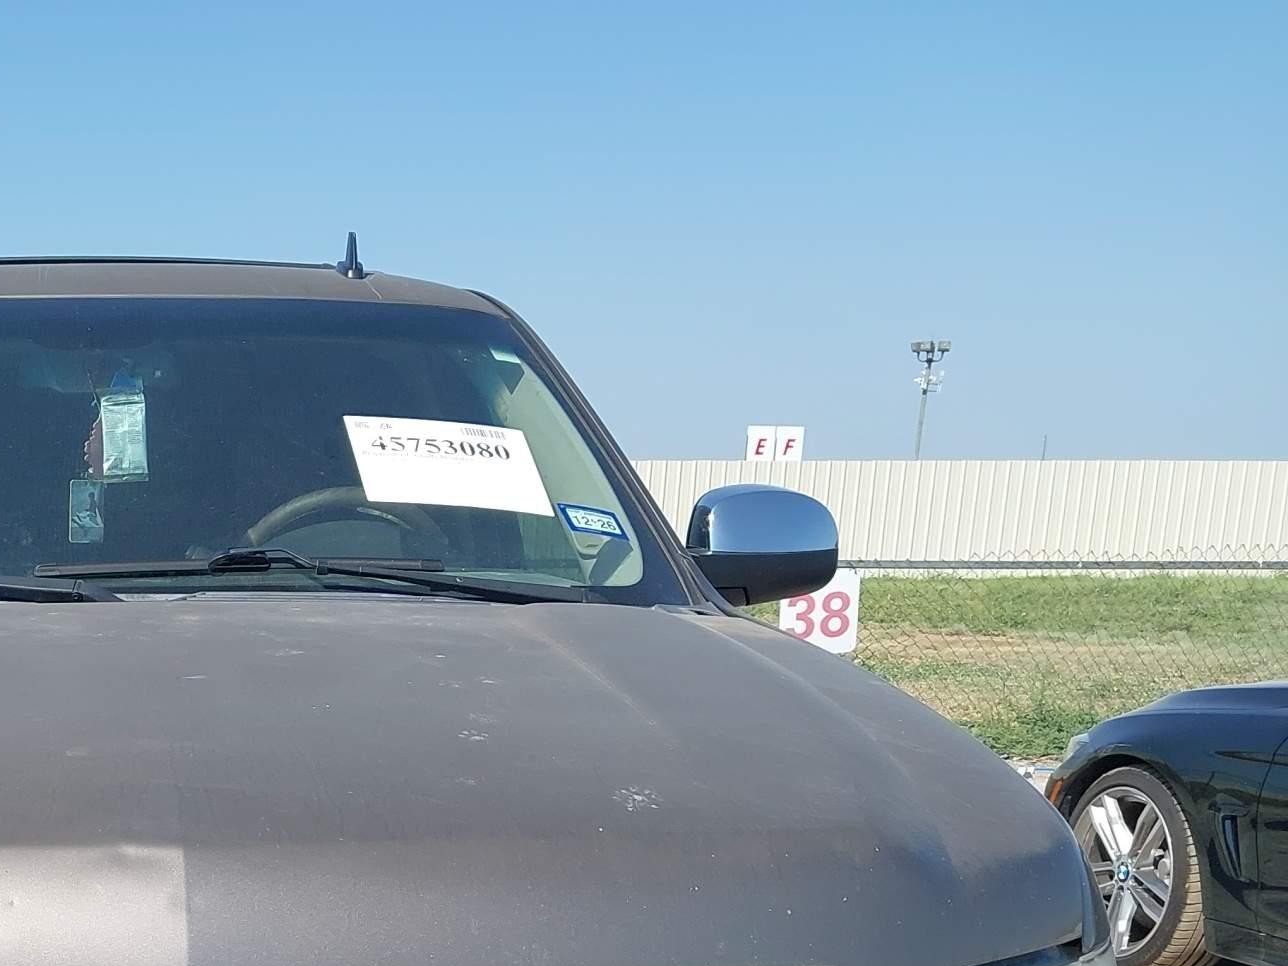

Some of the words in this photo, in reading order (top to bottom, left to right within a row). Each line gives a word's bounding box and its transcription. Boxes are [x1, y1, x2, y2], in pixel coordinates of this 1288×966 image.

[371, 435, 511, 461] 45753080
[755, 438, 768, 456] E
[783, 438, 796, 456] F
[787, 591, 851, 640] 38
